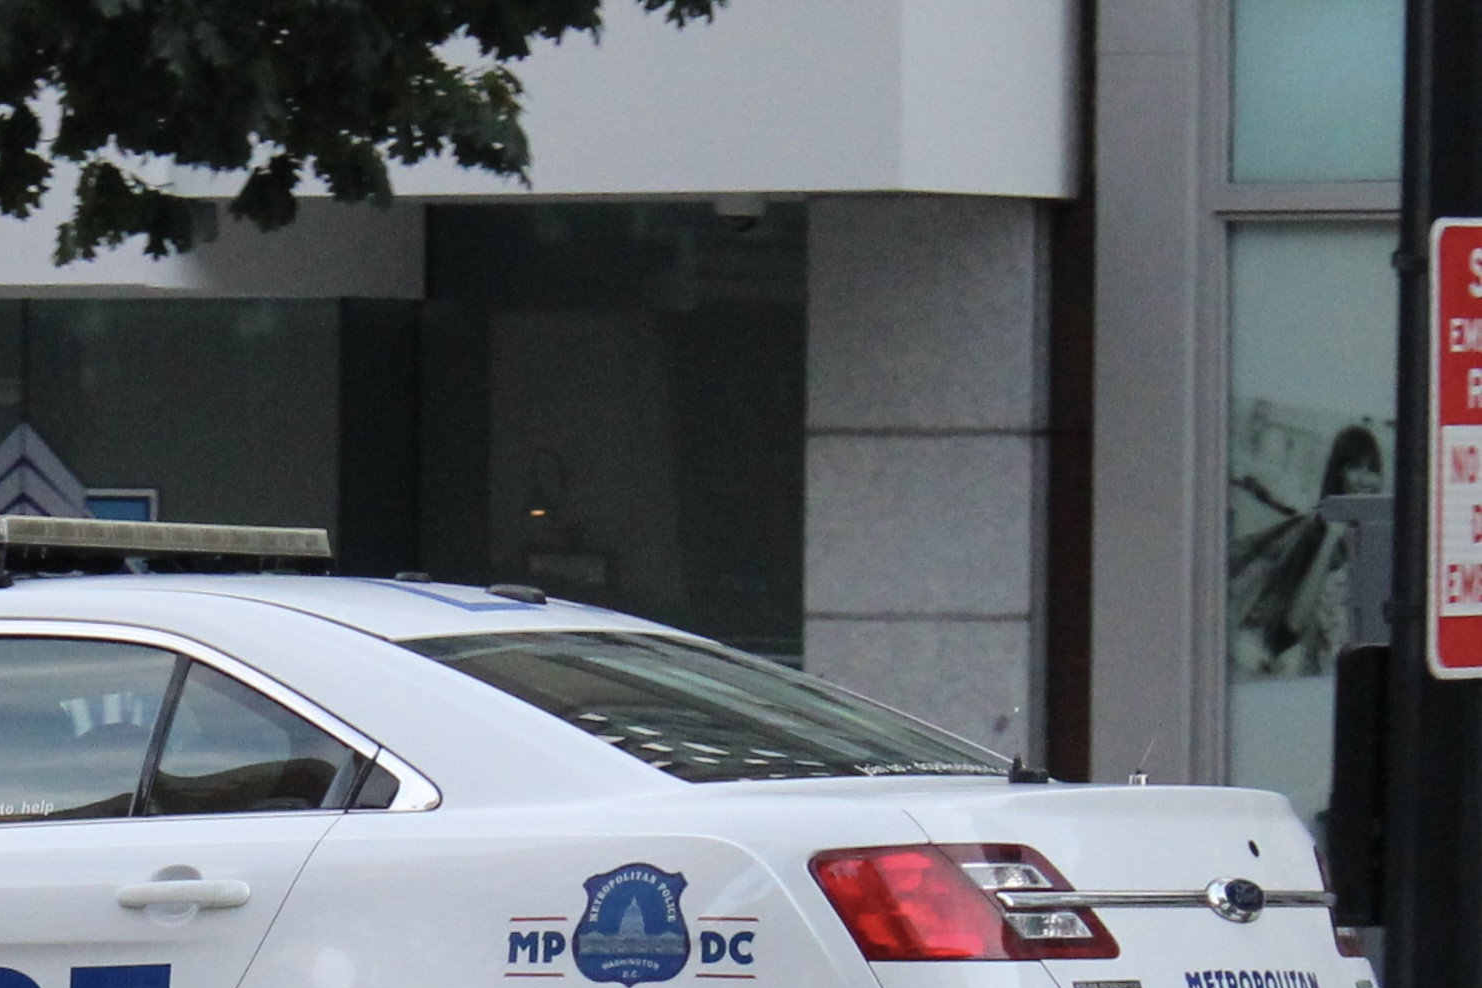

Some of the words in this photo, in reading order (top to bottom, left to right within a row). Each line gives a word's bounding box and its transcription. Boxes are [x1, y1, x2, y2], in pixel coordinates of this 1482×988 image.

[0, 802, 14, 816] to
[21, 800, 55, 817] help
[589, 871, 658, 922] METROPOLITAN
[658, 882, 677, 922] POLICE
[507, 930, 566, 964] MP
[700, 930, 756, 965] DC
[601, 958, 660, 971] WASHINGTON
